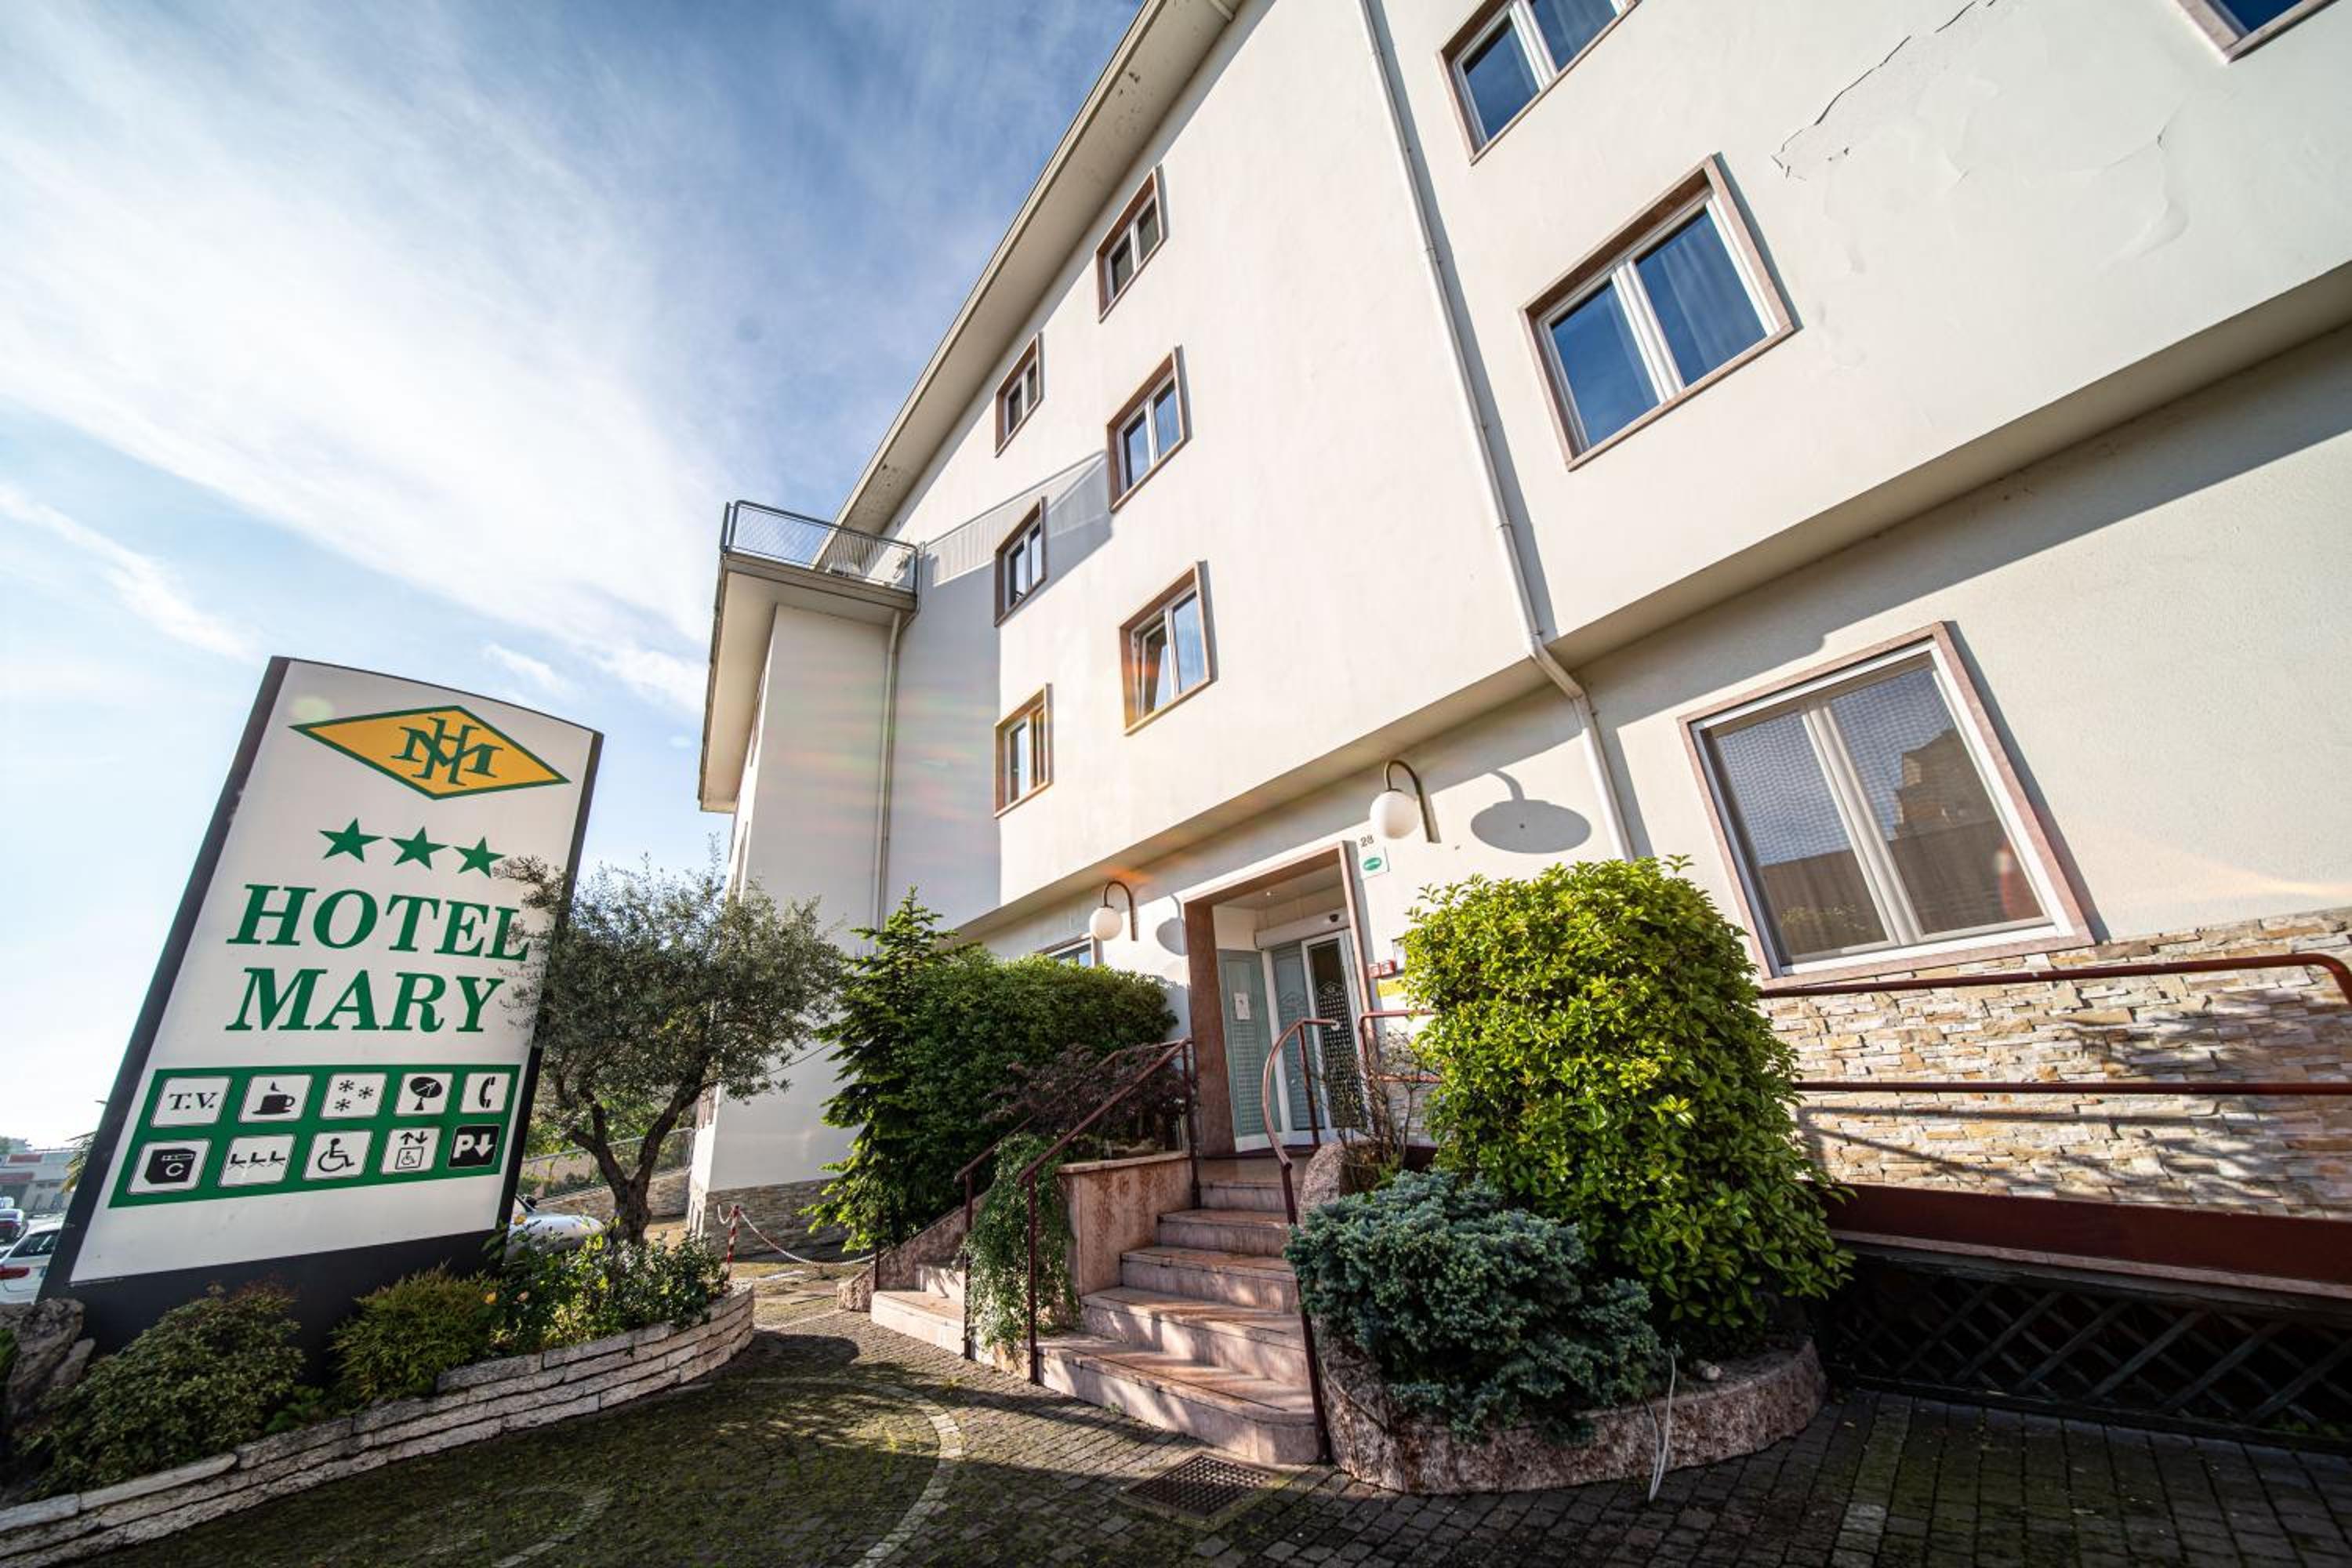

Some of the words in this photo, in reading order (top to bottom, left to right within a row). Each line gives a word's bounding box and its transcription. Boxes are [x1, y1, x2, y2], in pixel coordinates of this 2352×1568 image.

[226, 884, 529, 961] HOTEL
[225, 967, 505, 1033] MARY
[169, 1092, 219, 1110] T.V.
